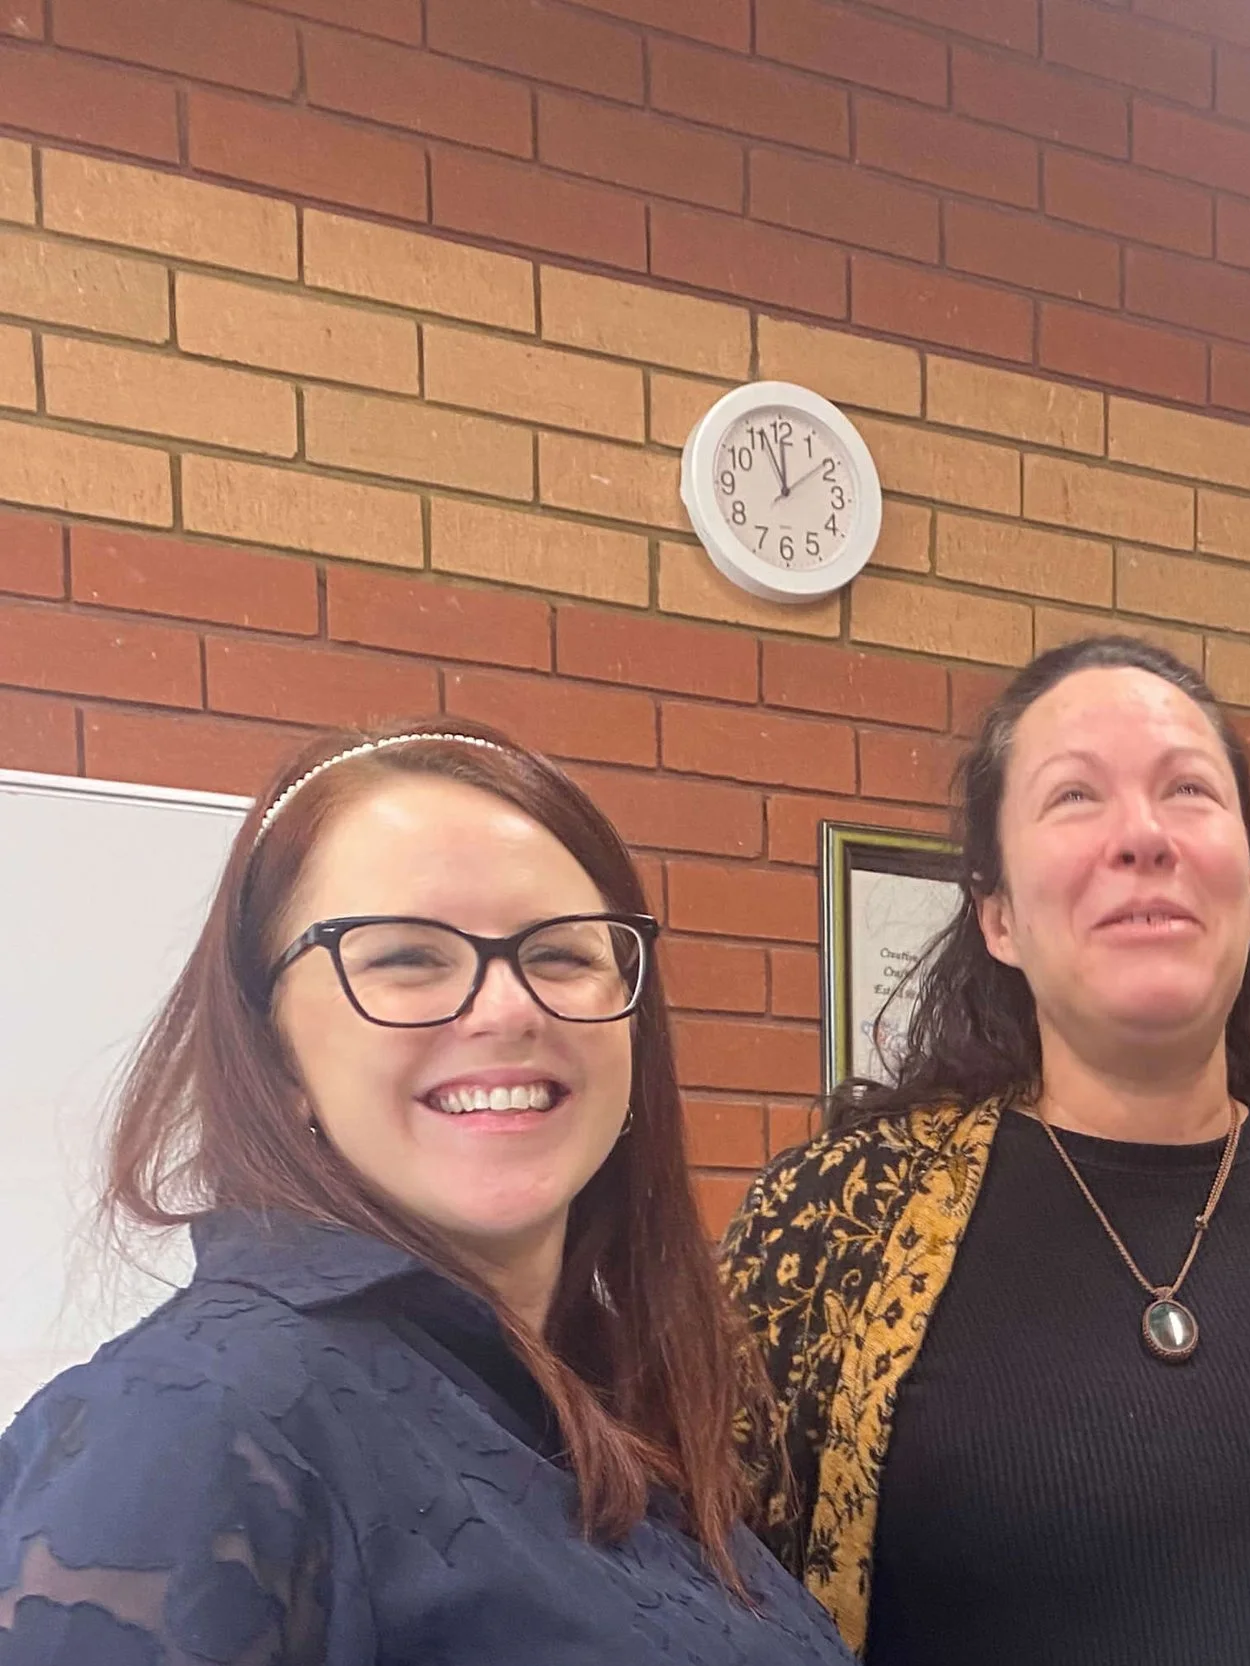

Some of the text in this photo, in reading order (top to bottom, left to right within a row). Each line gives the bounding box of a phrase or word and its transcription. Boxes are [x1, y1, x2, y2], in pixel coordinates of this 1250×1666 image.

[746, 426, 765, 450] 11
[770, 421, 793, 446] 12
[728, 446, 753, 471] 10
[803, 435, 812, 458] 1
[822, 458, 836, 482] 2
[720, 470, 735, 495] 9
[831, 486, 845, 510] 3
[732, 500, 746, 525] 8
[755, 525, 768, 549] 7
[824, 514, 839, 536] 4
[779, 536, 794, 561] 6
[806, 532, 820, 556] 5
